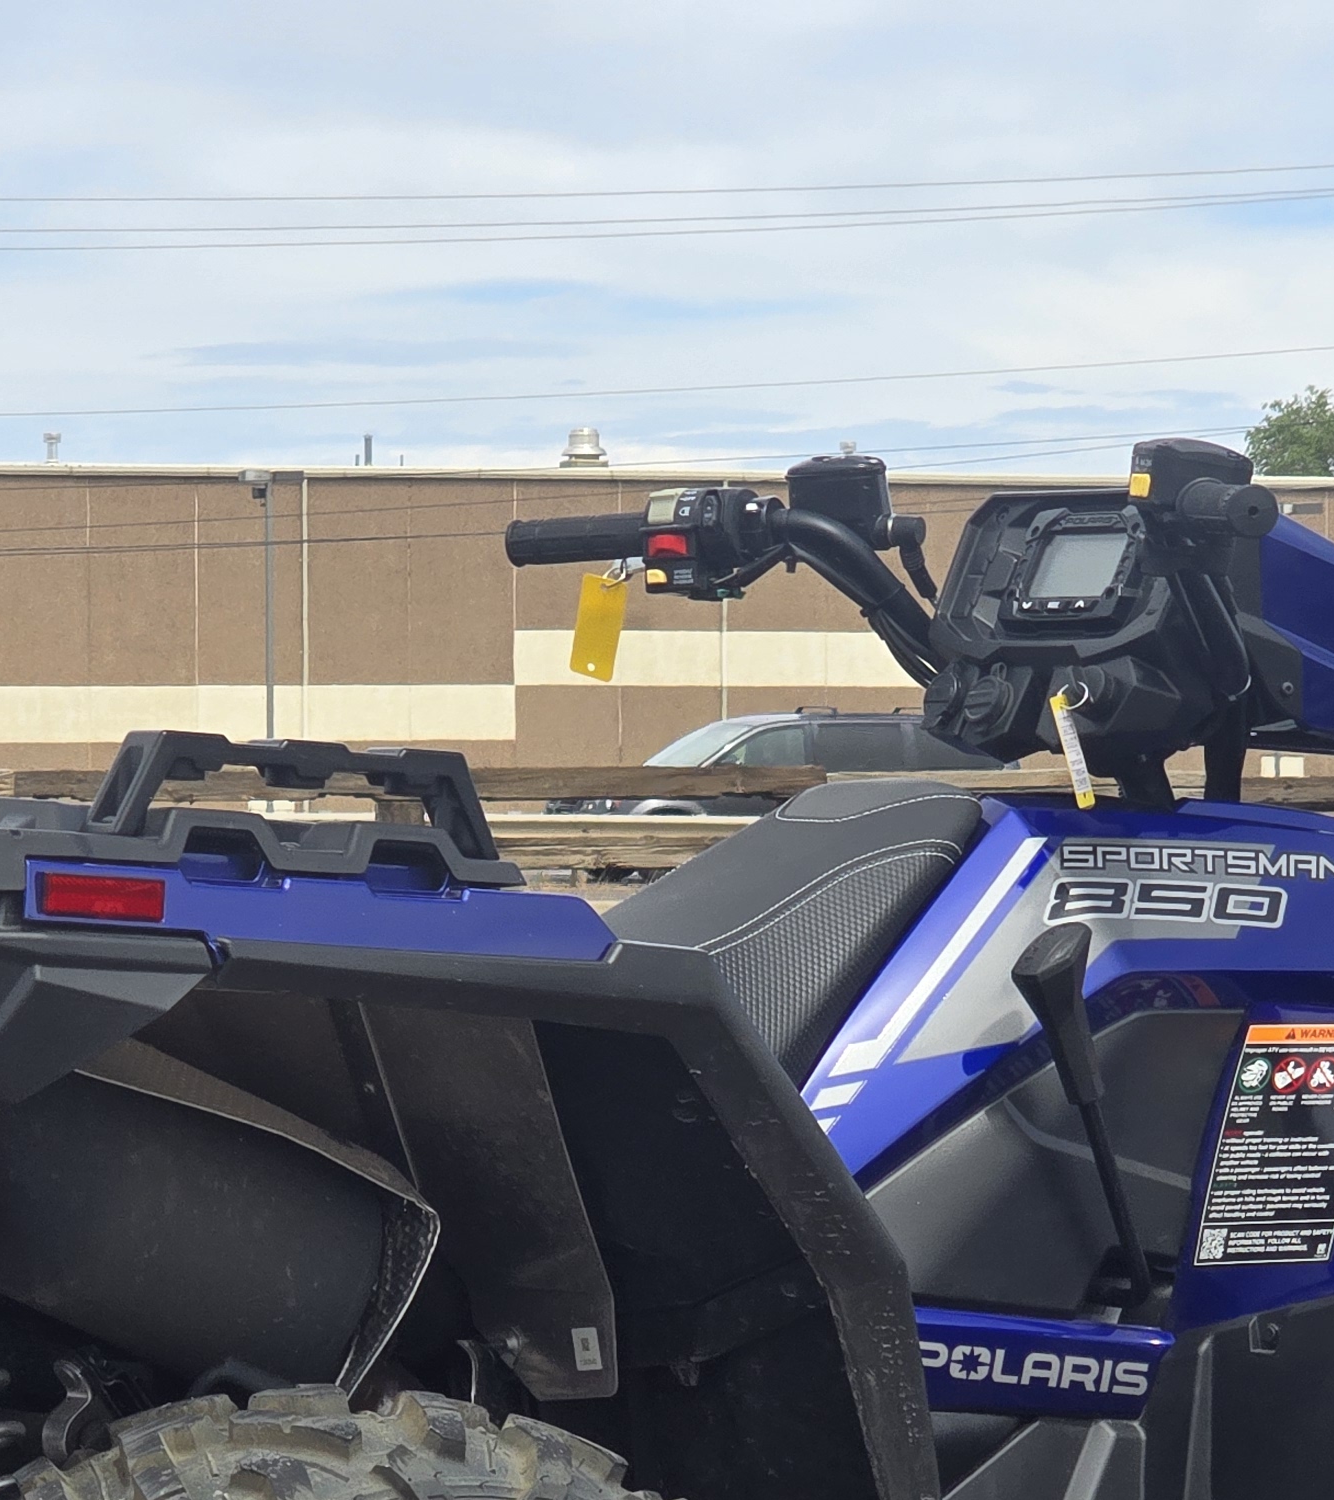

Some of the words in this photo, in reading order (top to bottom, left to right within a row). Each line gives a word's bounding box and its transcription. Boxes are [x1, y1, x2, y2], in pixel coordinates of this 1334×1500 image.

[1065, 515, 1117, 524] POLARIS
[1043, 876, 1287, 928] 850
[919, 1341, 1149, 1395] POLARIS
